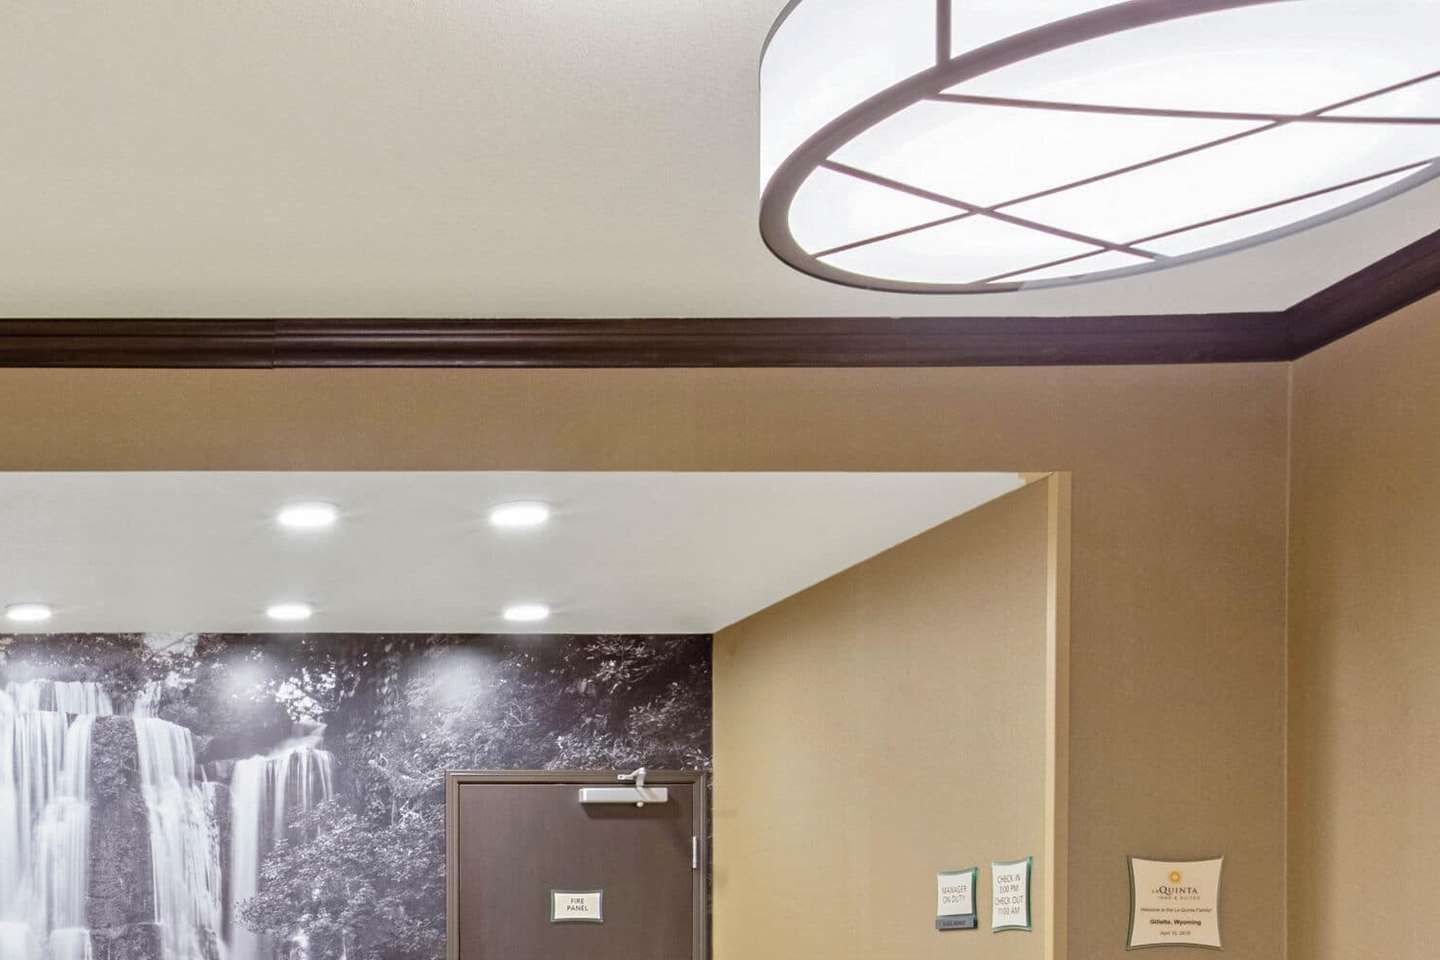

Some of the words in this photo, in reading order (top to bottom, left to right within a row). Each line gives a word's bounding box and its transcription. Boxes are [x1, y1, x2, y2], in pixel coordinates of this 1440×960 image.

[997, 874, 1014, 884] CHECK
[942, 884, 968, 894] MANAGER
[995, 896, 1012, 905] CHECK
[1012, 895, 1024, 904] OUT
[1173, 919, 1202, 927] Wyoming
